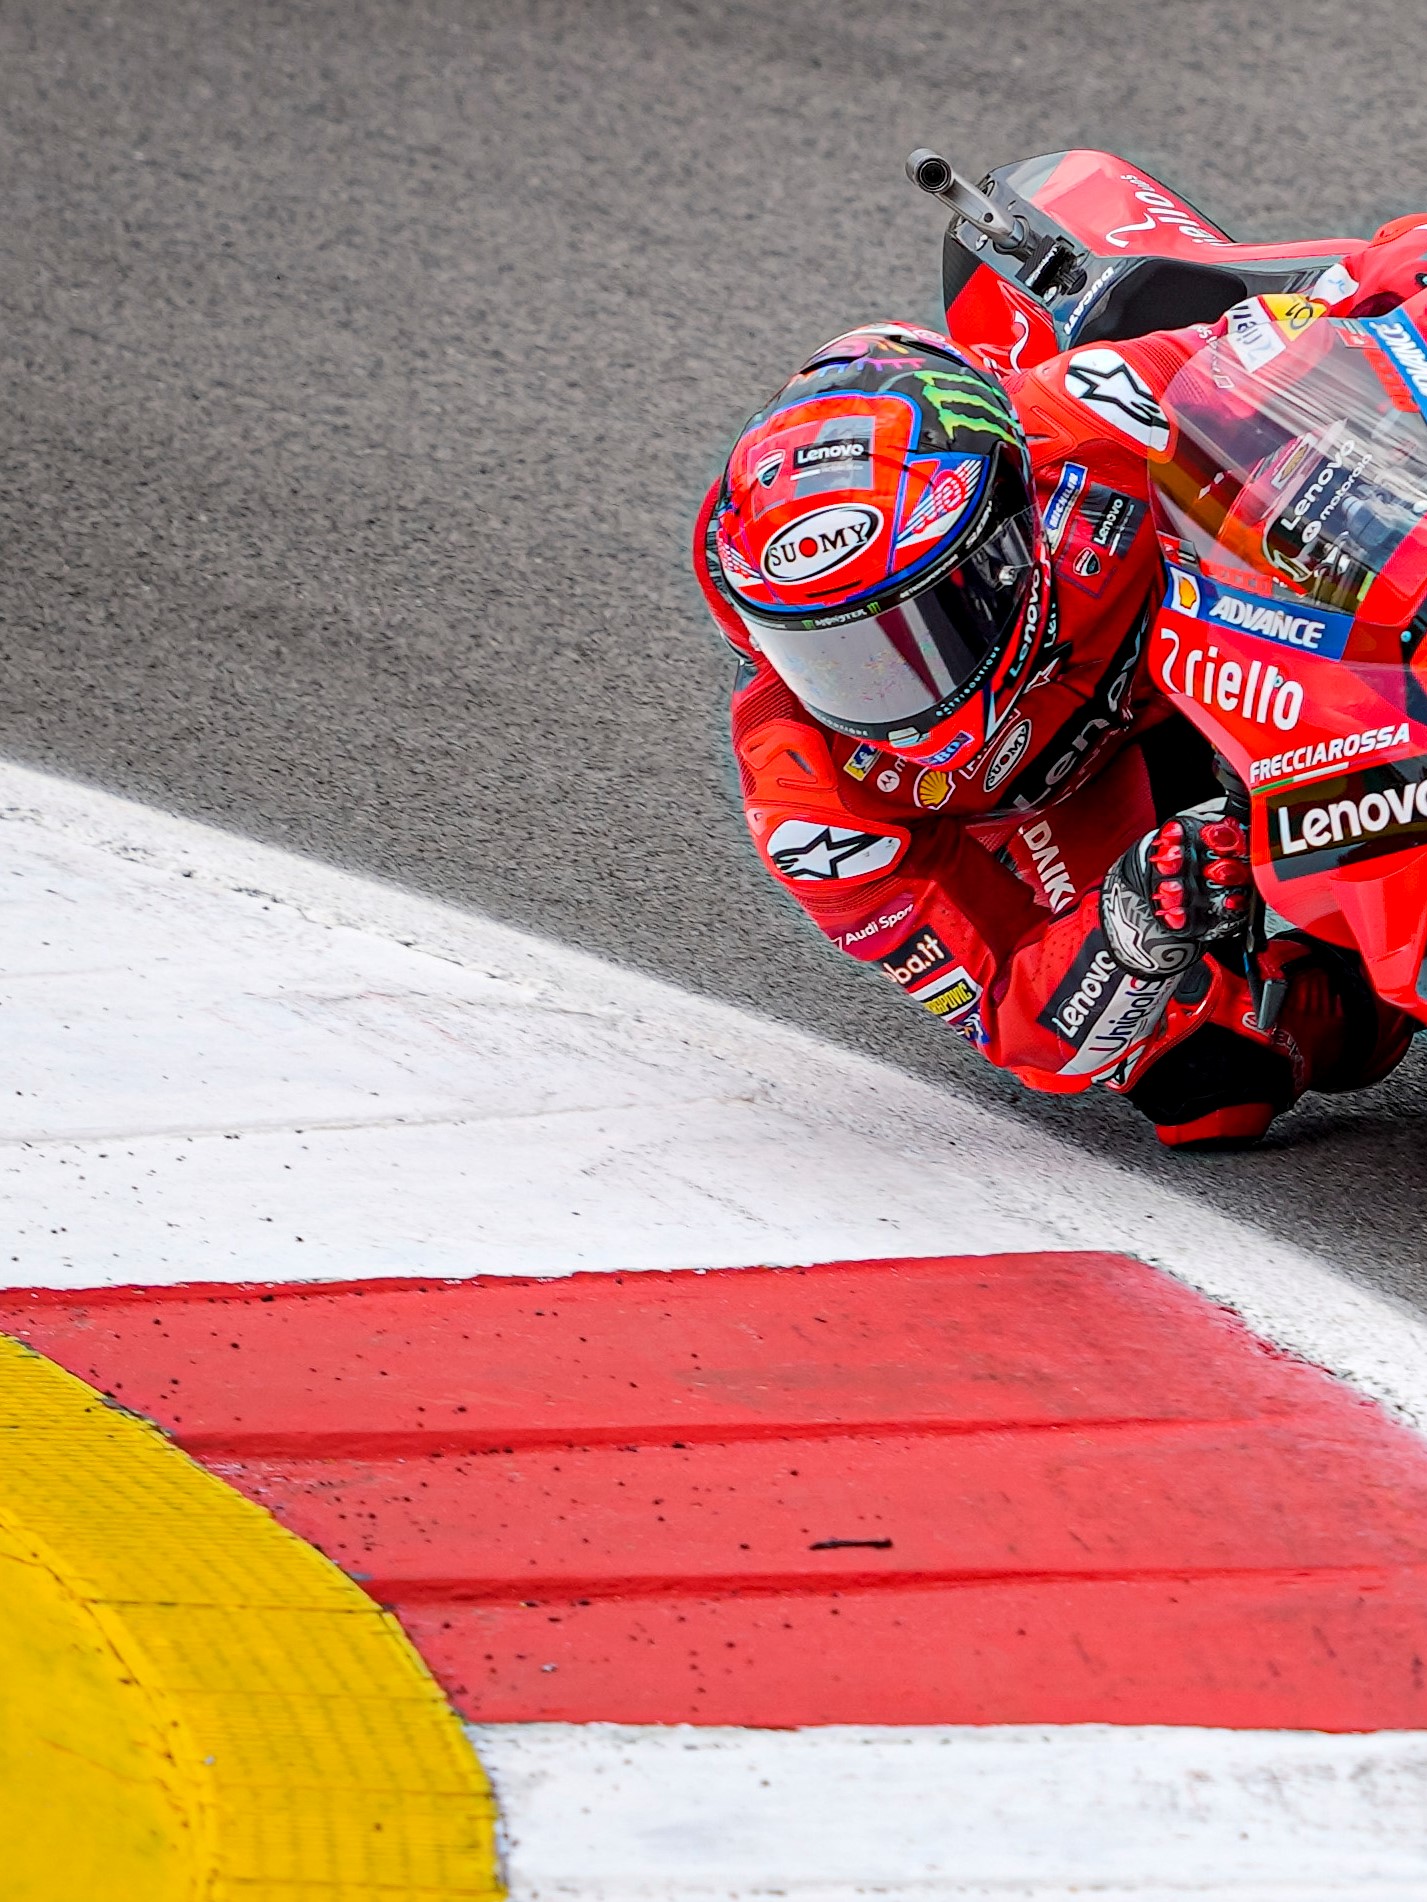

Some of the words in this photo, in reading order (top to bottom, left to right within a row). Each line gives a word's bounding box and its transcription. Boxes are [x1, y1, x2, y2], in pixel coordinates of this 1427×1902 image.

[797, 443, 865, 464] Lenovo
[1280, 440, 1355, 530] Lenovo
[1319, 453, 1373, 521] motorola
[768, 521, 867, 567] SUOMY
[1093, 498, 1124, 545] Lenovo
[1008, 568, 1040, 677] Lenovo
[1208, 594, 1326, 649] ADVANCE
[986, 725, 1028, 787] SUOMY
[1250, 722, 1411, 784] FRECCIAROSSA
[845, 921, 879, 946] Audi
